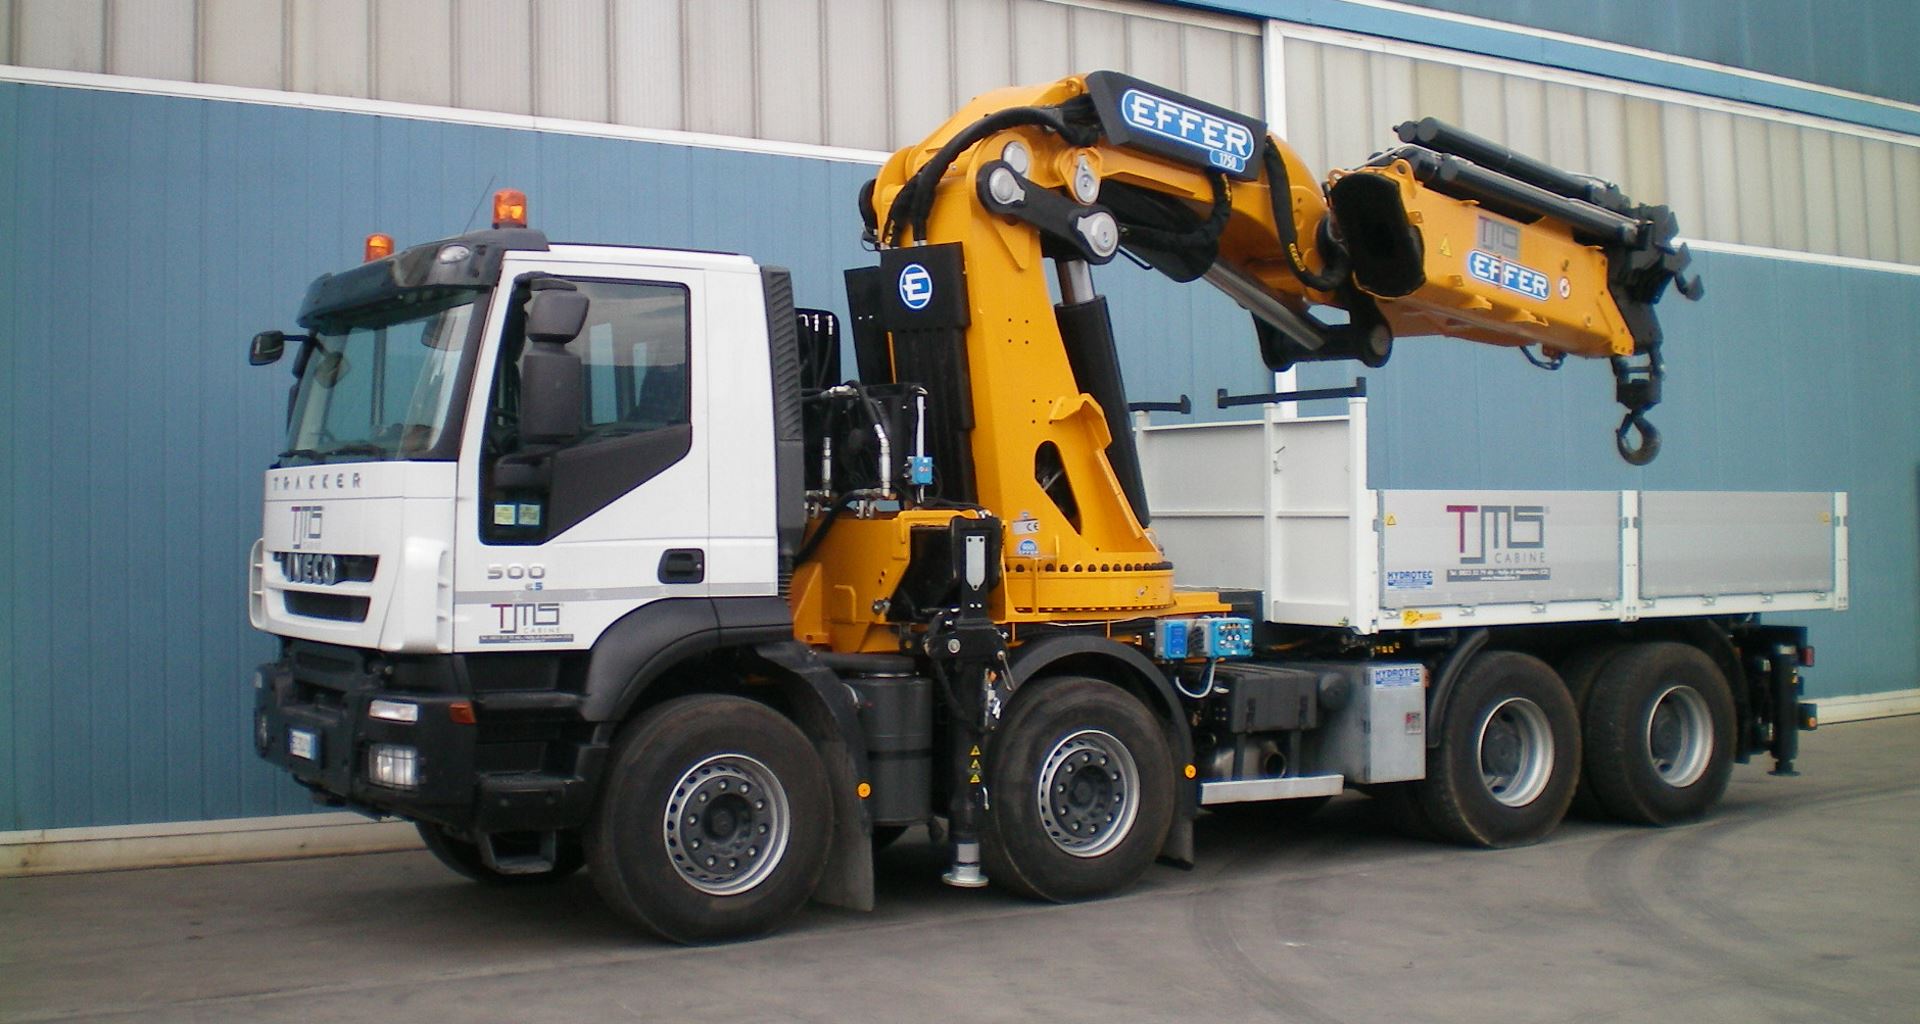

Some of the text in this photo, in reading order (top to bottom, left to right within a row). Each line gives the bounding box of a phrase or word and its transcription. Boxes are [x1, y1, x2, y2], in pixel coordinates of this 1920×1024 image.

[1130, 95, 1248, 156] EFFER
[901, 271, 930, 301] E
[1473, 253, 1548, 297] EFFER
[273, 472, 361, 490] TRAKKER
[291, 505, 323, 549] TMS
[1446, 504, 1544, 564] TMS
[487, 564, 545, 579] 500
[1494, 552, 1545, 564] CABINE
[1387, 570, 1433, 580] HYDROTEC
[490, 602, 560, 633] TMS
[1375, 668, 1420, 679] HYDROTEC
